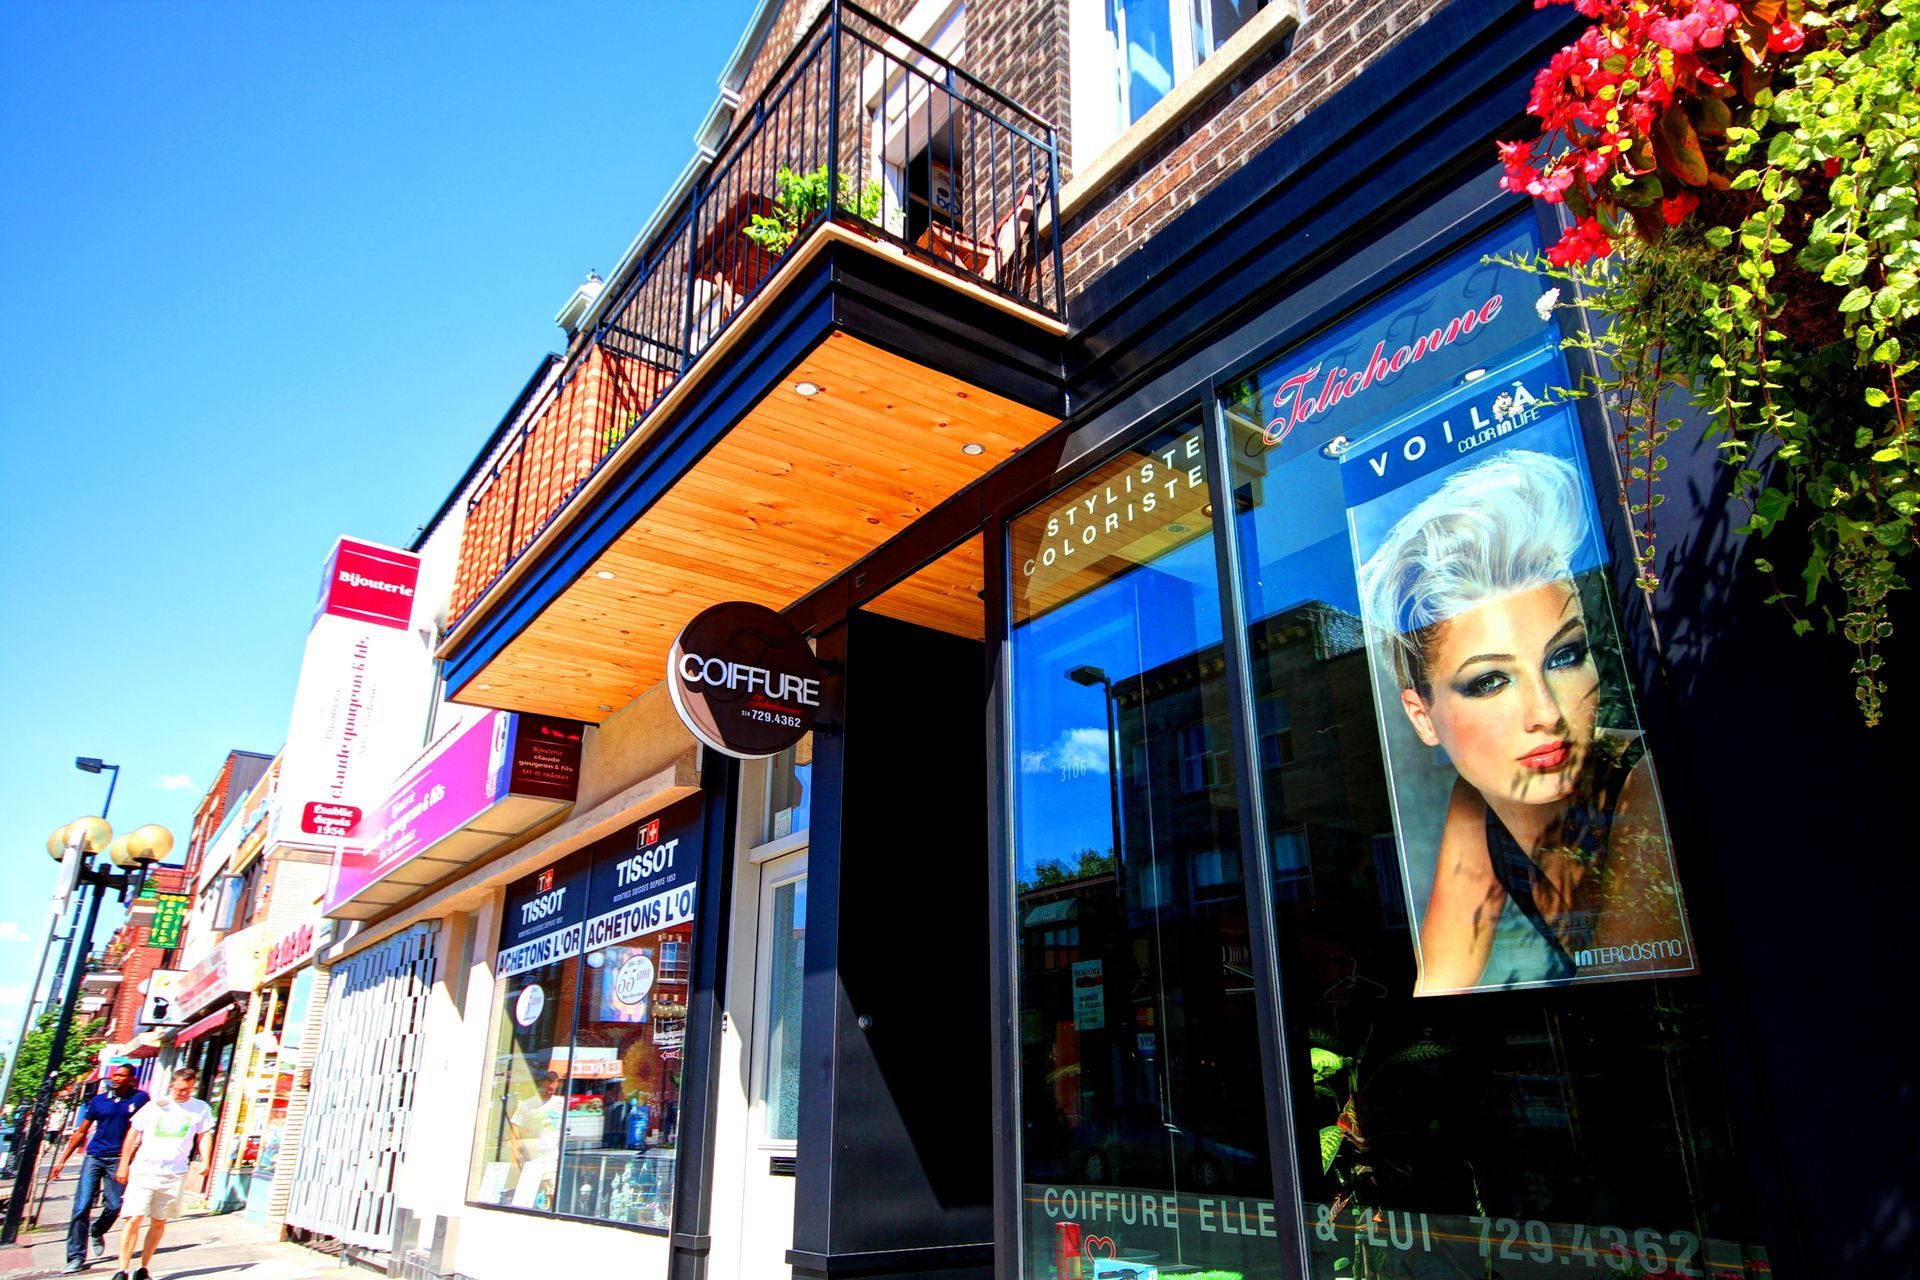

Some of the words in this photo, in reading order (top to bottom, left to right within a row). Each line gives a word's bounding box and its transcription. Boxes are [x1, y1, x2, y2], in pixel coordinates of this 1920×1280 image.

[1458, 427, 1496, 454] COLOR
[1511, 406, 1541, 430] LIFE
[1047, 436, 1200, 537] STYLISTE
[1023, 465, 1203, 577] COLORISTE
[338, 570, 413, 597] Bijouterie
[679, 654, 820, 707] COIFFURE
[751, 709, 801, 729] 729.4362
[518, 760, 554, 769] gougeon
[534, 755, 561, 763] claude
[316, 826, 346, 836] 1956
[616, 838, 679, 888] TISSOT
[521, 887, 566, 926] TISSOT
[587, 899, 661, 948] ACHETONS
[497, 938, 551, 975] ACHETONS
[553, 928, 581, 957] L'OR
[1044, 1187, 1179, 1229] COIFFURE
[1200, 1198, 1277, 1238] ELLE
[1315, 1203, 1339, 1242] &
[1367, 1209, 1432, 1252] LUI
[1469, 1216, 1704, 1278] 729.4362
